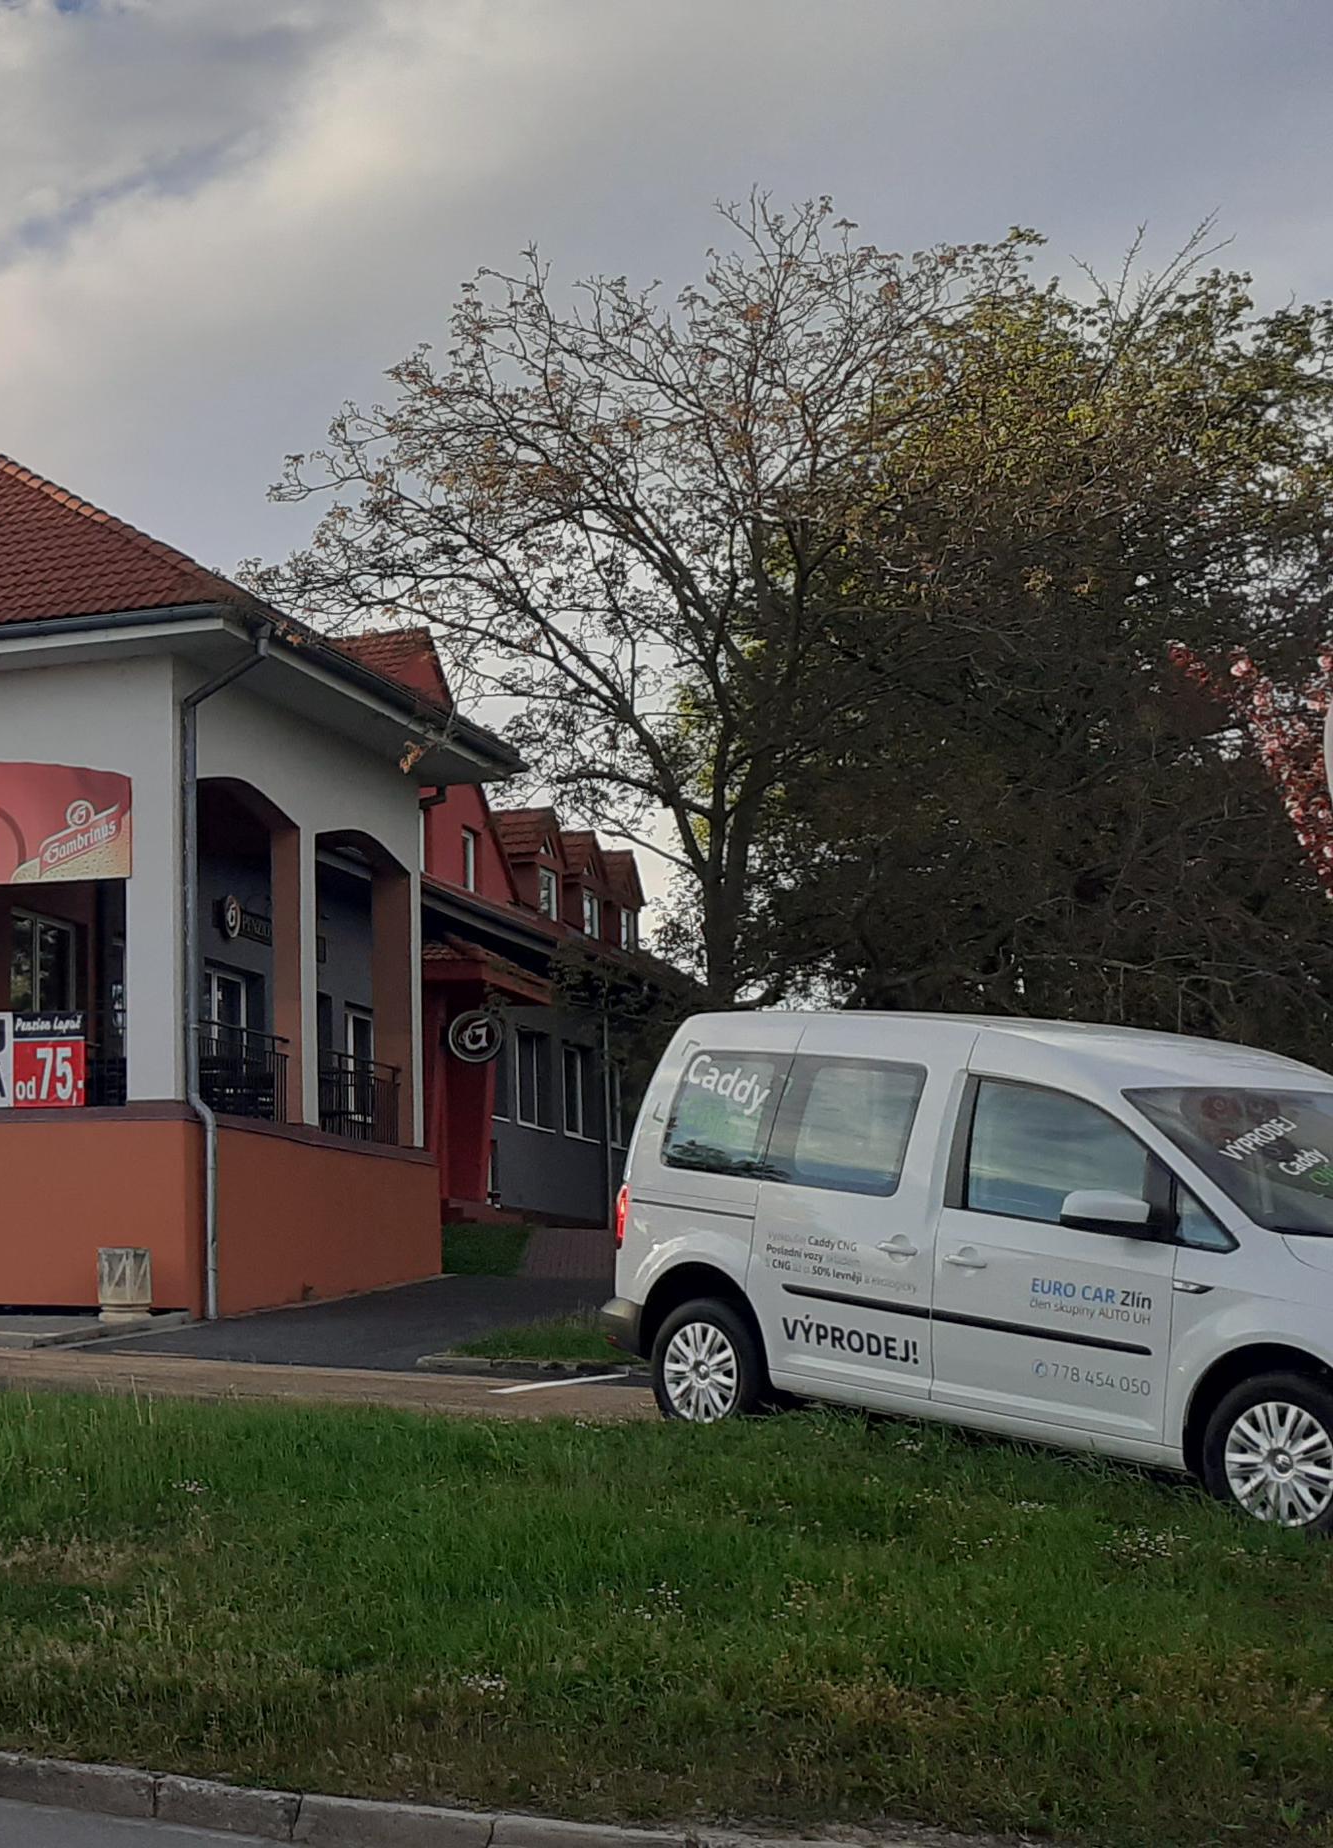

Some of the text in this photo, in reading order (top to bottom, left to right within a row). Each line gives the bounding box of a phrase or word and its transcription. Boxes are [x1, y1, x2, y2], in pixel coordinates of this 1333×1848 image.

[43, 820, 117, 864] Gambrinus
[15, 1015, 82, 1033] Penzion Lapač
[15, 1076, 37, 1100] od
[688, 1054, 771, 1116] Caddy
[1218, 1115, 1297, 1161] VÝPRODEJ
[1278, 1148, 1330, 1176] Caddy
[766, 1243, 802, 1259] Poslední
[803, 1250, 824, 1263] vozy
[807, 1236, 835, 1250] Caddy
[837, 1240, 858, 1252] CNG
[772, 1259, 791, 1271] CNG
[812, 1265, 831, 1278] 50%
[833, 1269, 863, 1285] levněji
[1031, 1278, 1152, 1310] EURO CAR Zlín
[1030, 1296, 1151, 1326] člen skupiny AUTO UH
[782, 1314, 920, 1365] VÝPRODEJ!
[1052, 1363, 1151, 1396] 778 454 050
